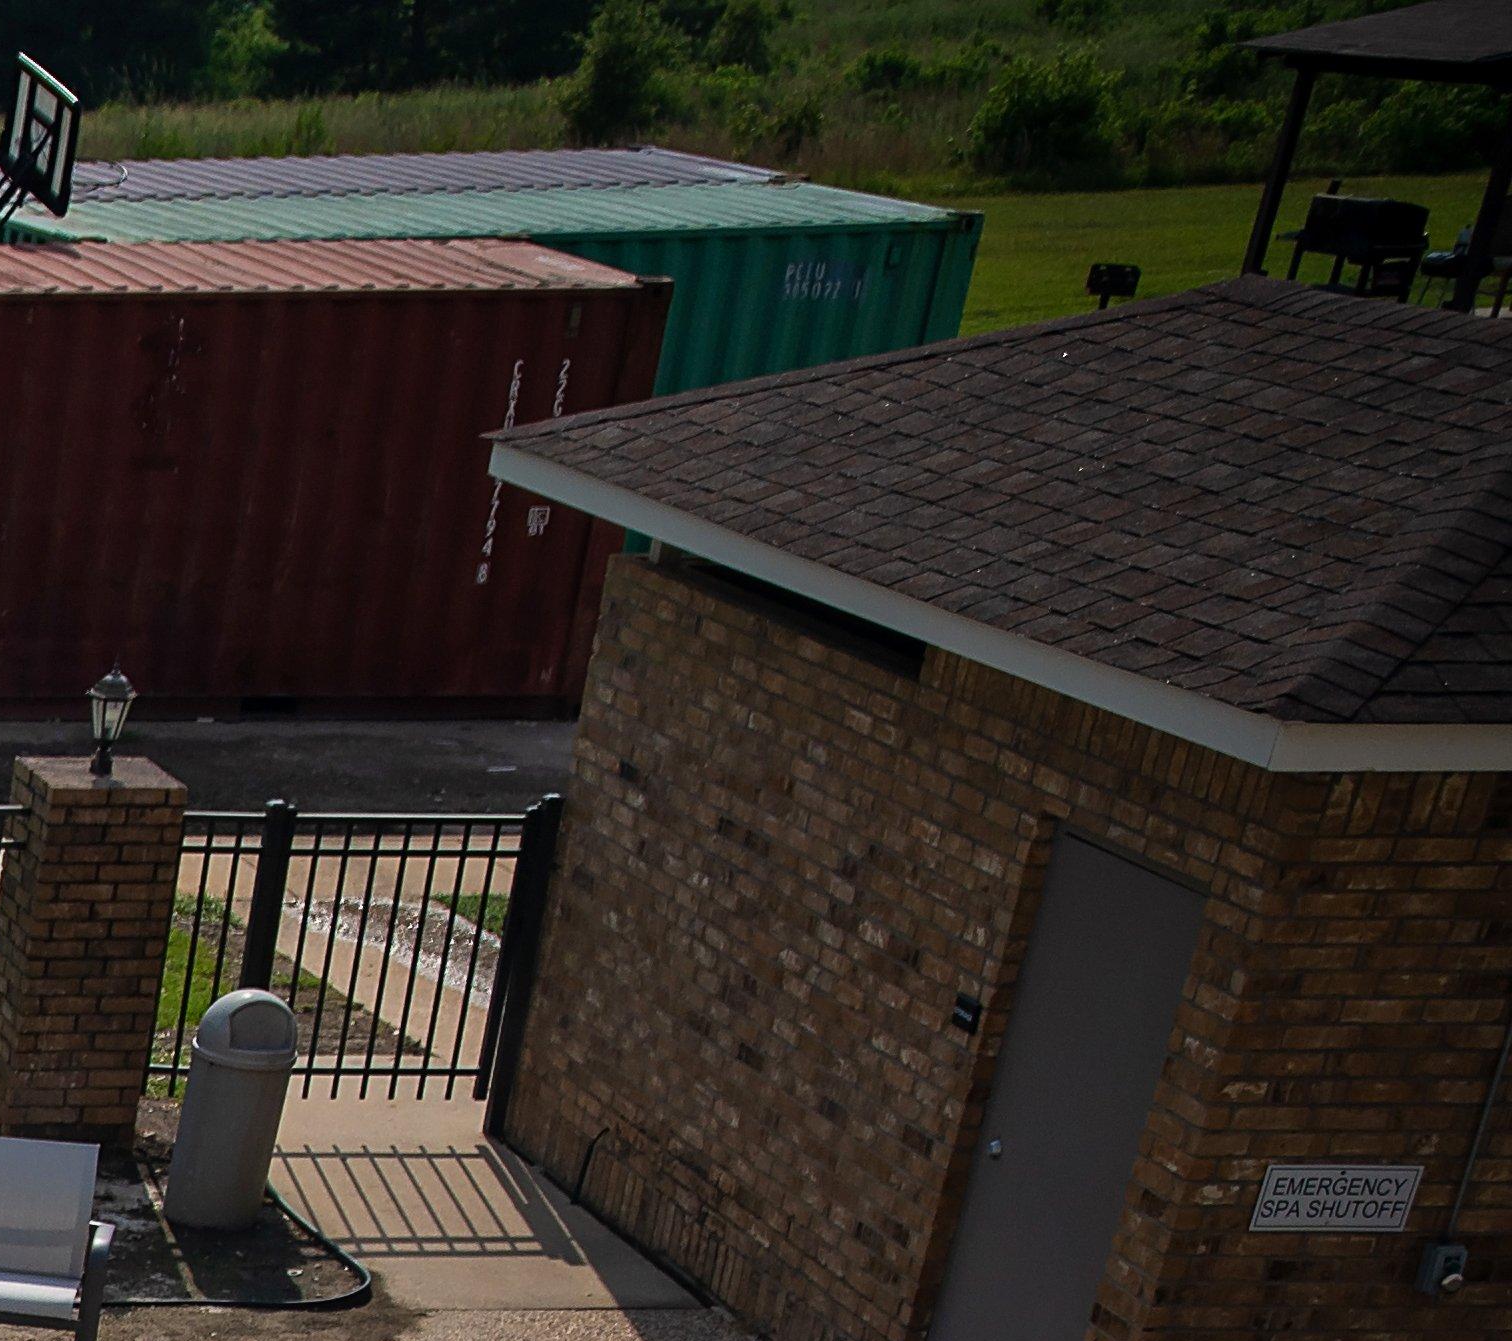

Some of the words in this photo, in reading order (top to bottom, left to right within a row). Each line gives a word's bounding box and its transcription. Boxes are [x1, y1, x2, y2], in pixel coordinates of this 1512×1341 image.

[1272, 1177, 1407, 1196] EMERGENCY
[1261, 1200, 1300, 1218] SPA
[1306, 1200, 1407, 1218] SHUTOFF
